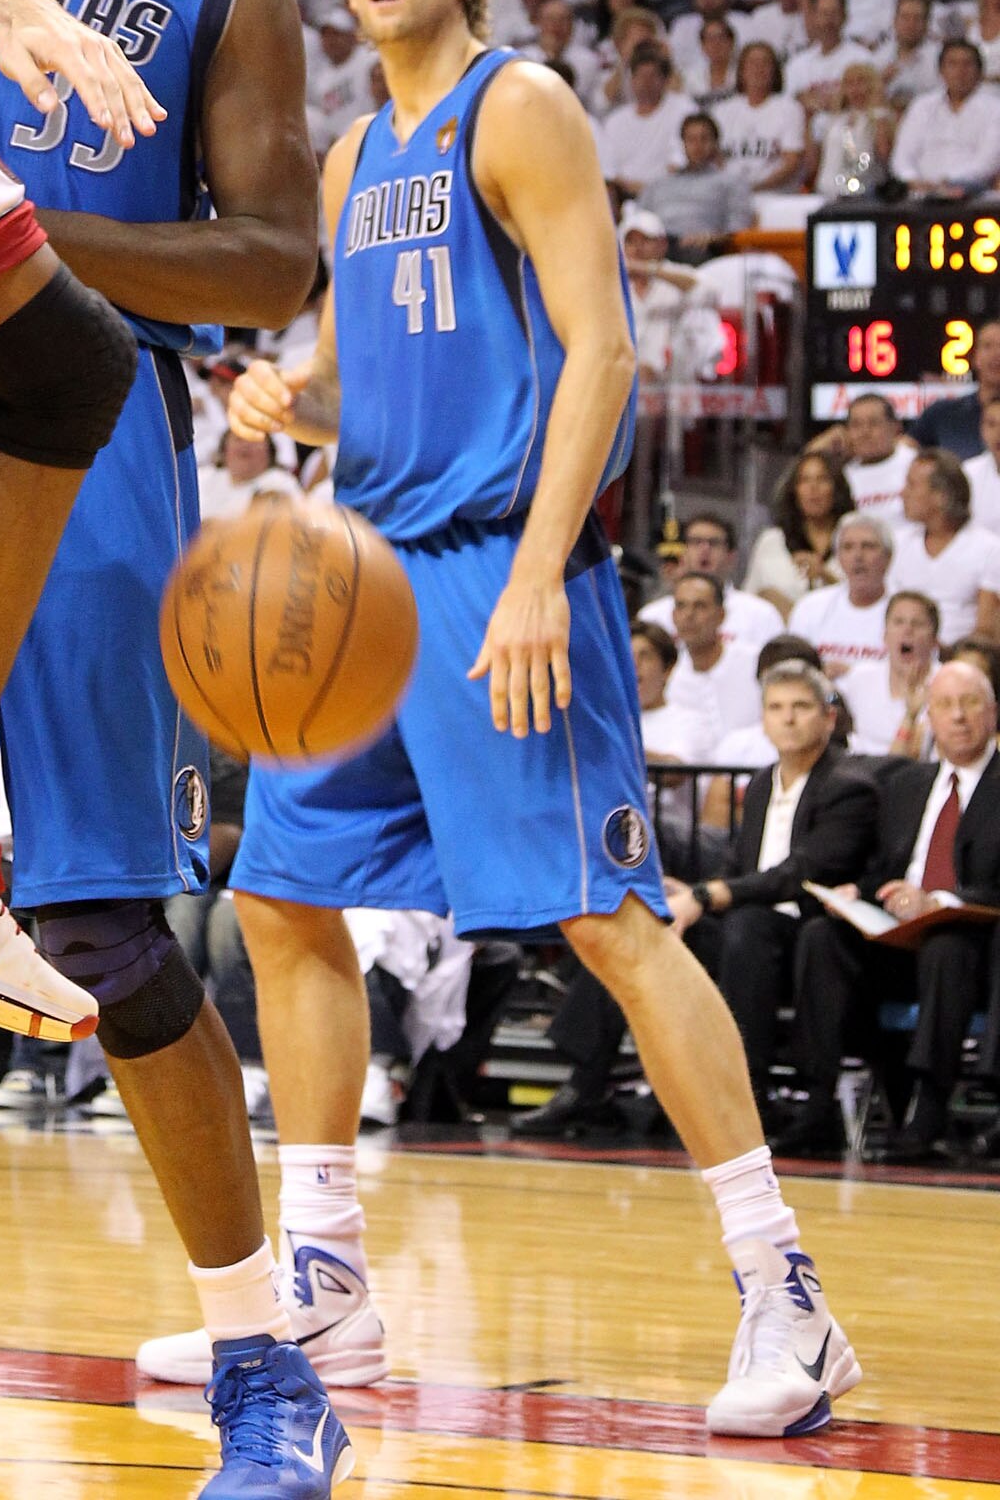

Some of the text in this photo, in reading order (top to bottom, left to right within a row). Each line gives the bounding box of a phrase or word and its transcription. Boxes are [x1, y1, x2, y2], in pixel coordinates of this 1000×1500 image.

[344, 169, 454, 258] DALLAS
[392, 245, 457, 335] 41
[848, 320, 974, 377] 16 2
